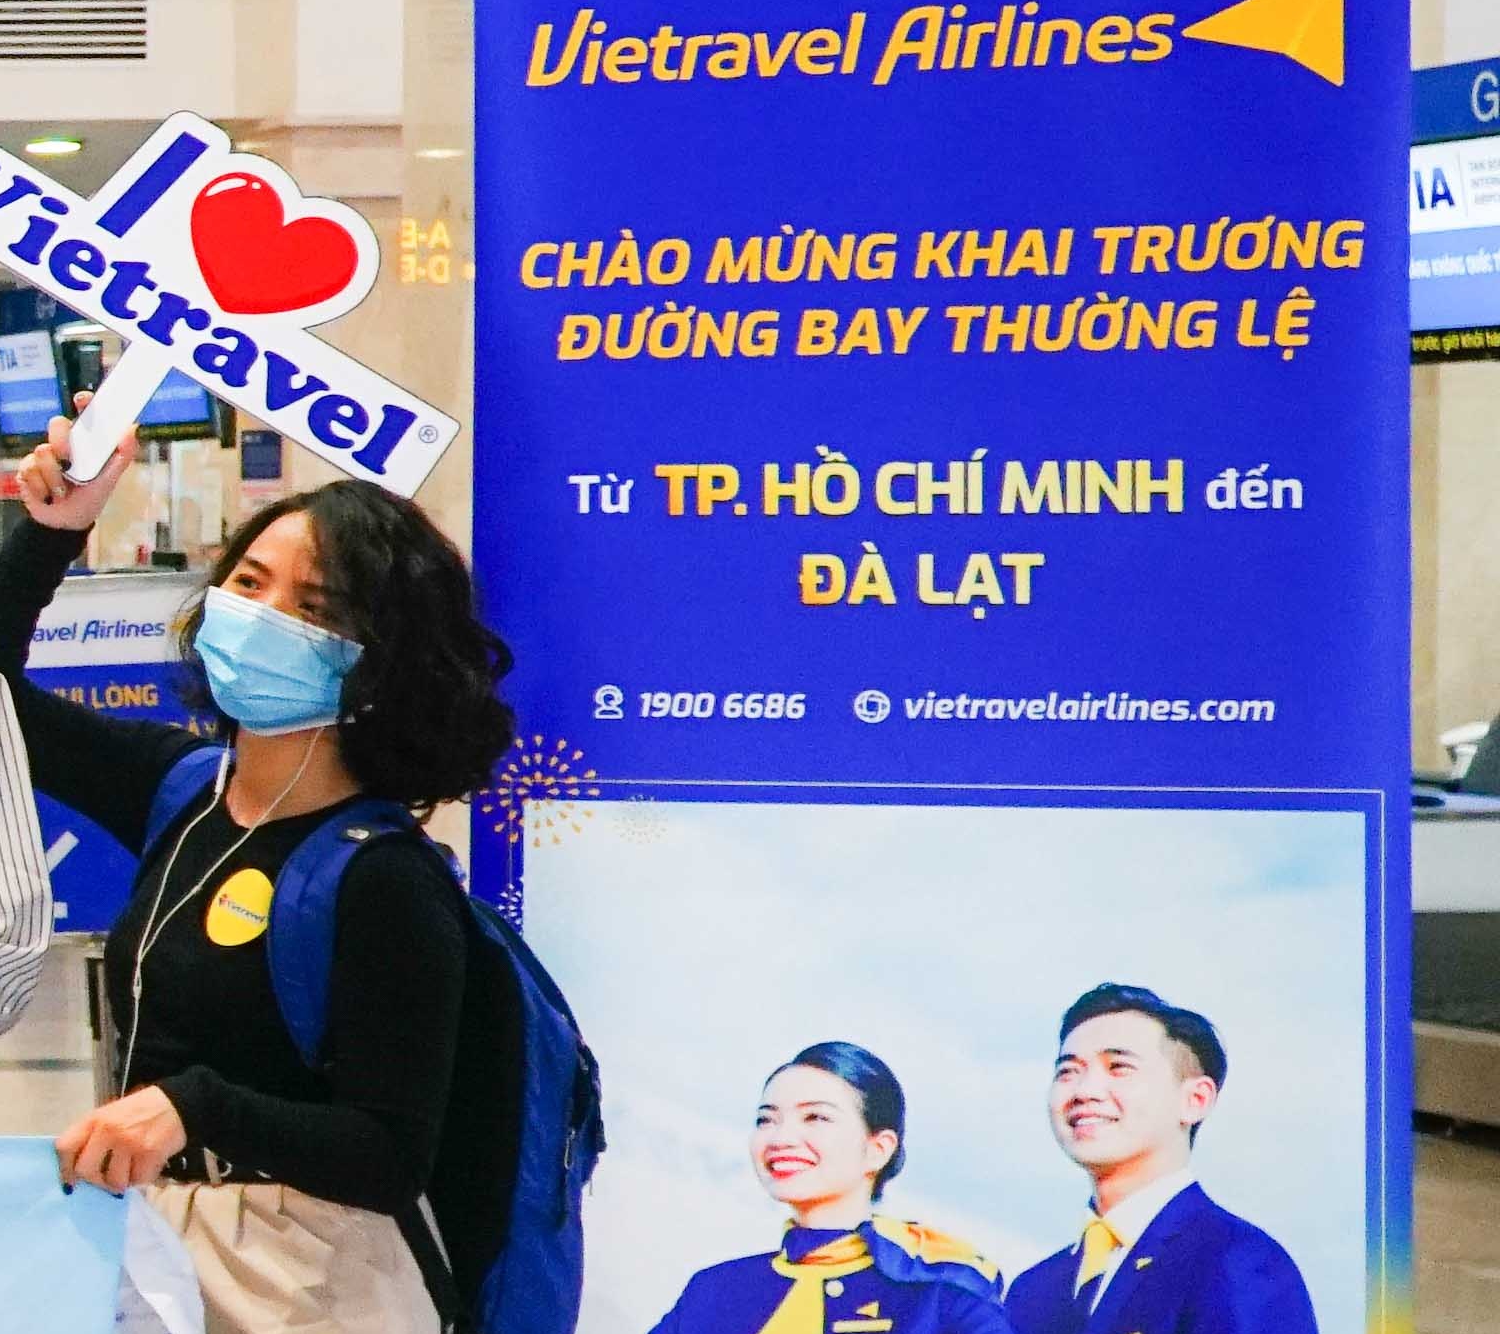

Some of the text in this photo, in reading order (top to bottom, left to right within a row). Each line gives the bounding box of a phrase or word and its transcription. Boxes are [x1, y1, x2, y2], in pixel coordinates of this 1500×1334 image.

[525, 3, 1175, 87] Vietravel Airlines
[95, 129, 208, 239] I
[519, 228, 691, 289] CHÀO
[707, 223, 897, 284] MỪNG
[913, 224, 1070, 276] KHAI
[1093, 214, 1366, 275] TRƯƠNG
[557, 285, 1317, 364] ĐƯỜNG BAY THƯỜNG LỆ
[569, 444, 1305, 517] Từ TP. HỒ CHÍ MINH đến
[798, 541, 1044, 620] ĐÀ LẠT
[81, 619, 167, 644] Airlines
[91, 680, 160, 709] LÒNG
[638, 689, 1277, 725] 1900 6686 vietravelairlines.com
